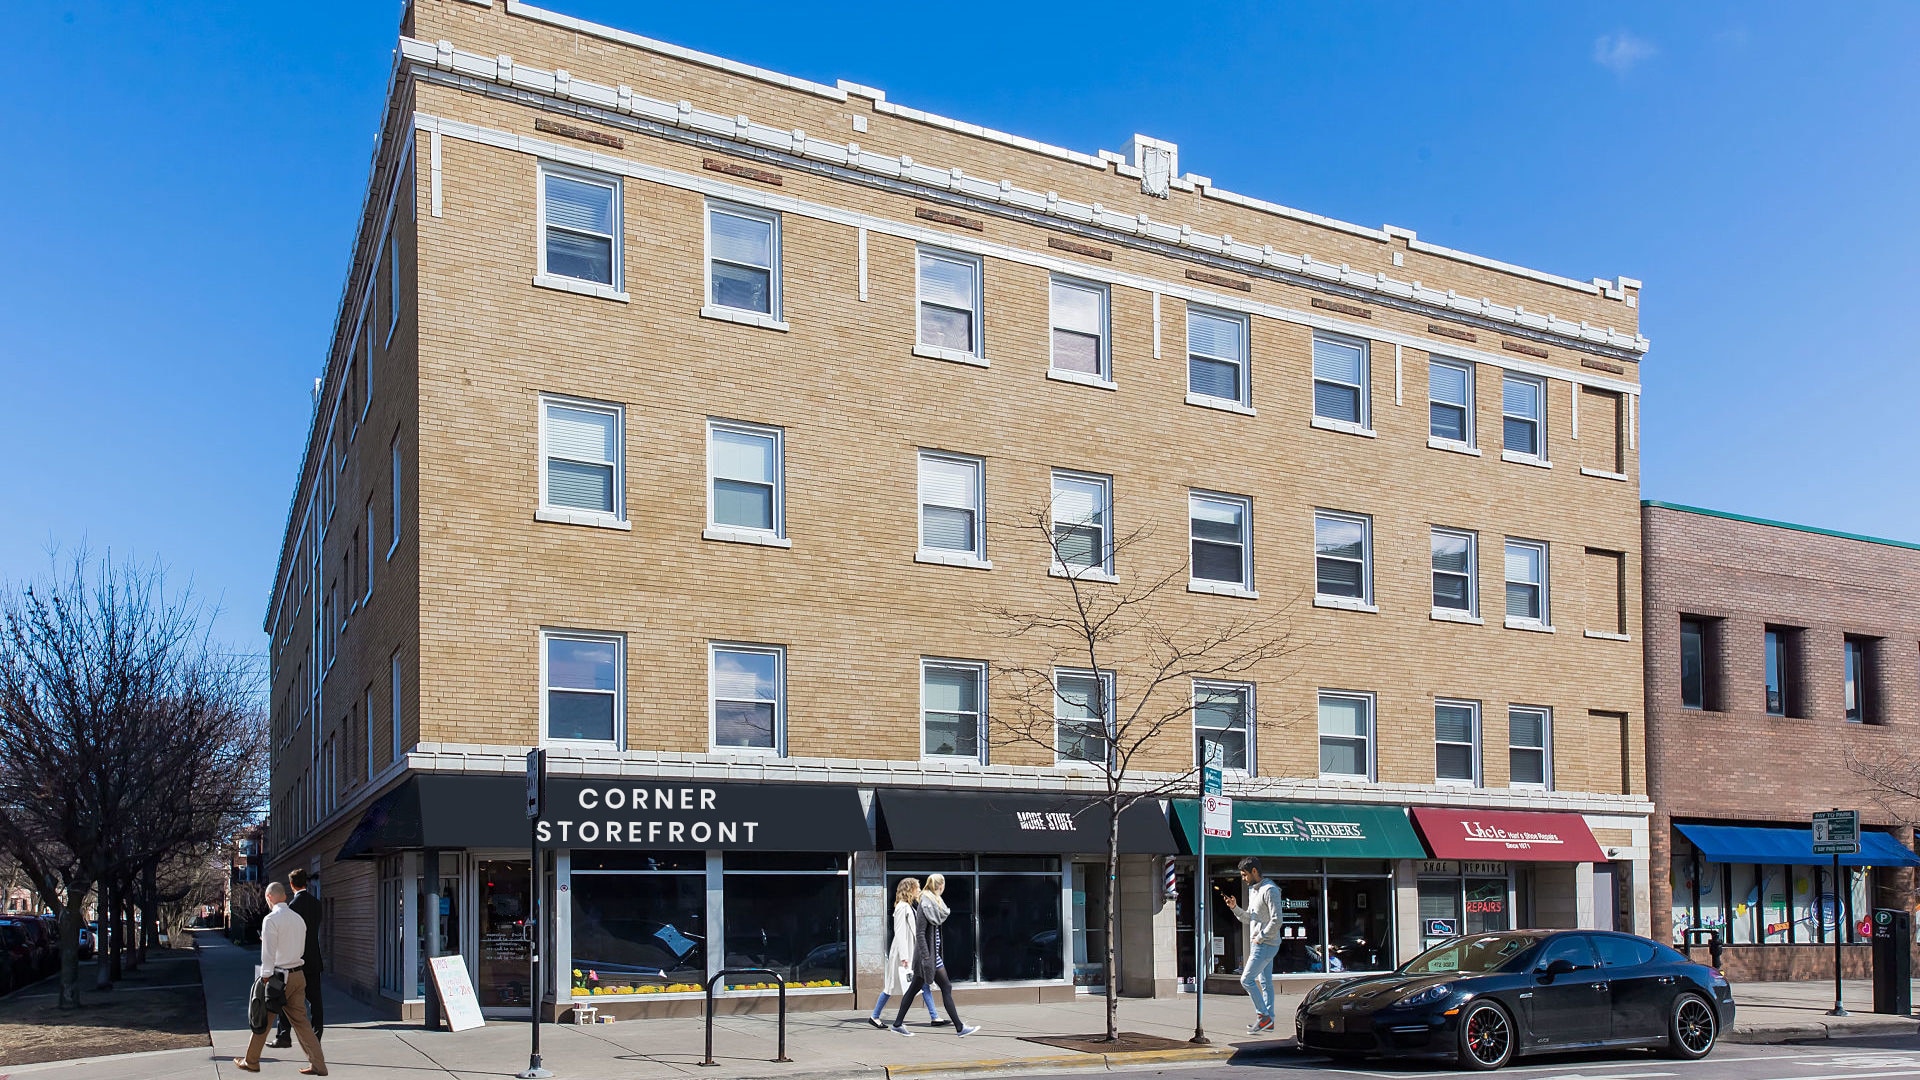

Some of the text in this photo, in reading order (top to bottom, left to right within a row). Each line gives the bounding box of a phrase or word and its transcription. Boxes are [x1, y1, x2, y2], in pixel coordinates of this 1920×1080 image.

[578, 788, 717, 810] CORNER
[1016, 811, 1047, 830] MORE
[536, 821, 759, 843] STOREFRONT
[1244, 822, 1281, 834] STATE
[1307, 824, 1362, 836] BARBERS
[1423, 862, 1501, 873] SHOE REPAIRS
[1466, 901, 1502, 913] REPAIRS
